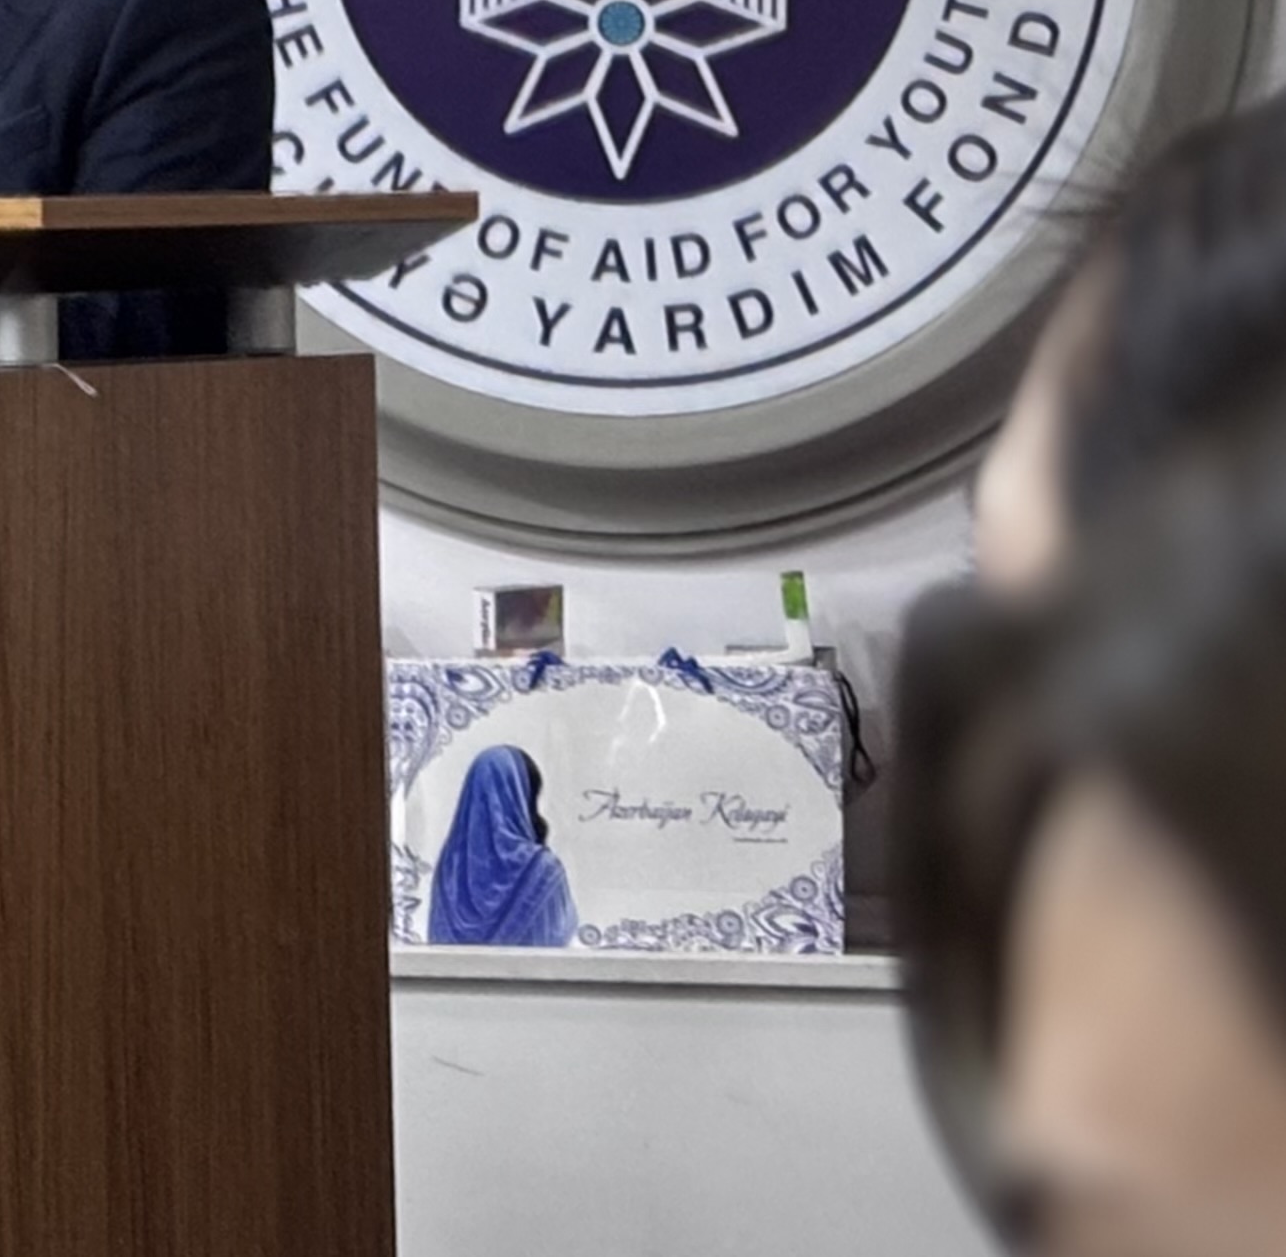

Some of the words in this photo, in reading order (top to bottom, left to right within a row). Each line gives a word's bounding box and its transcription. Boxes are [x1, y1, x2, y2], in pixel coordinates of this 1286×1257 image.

[305, 79, 449, 192] FUN
[477, 214, 569, 271] OF
[591, 232, 711, 283] AID
[733, 164, 870, 262] FOR
[533, 234, 889, 355] YARDIM
